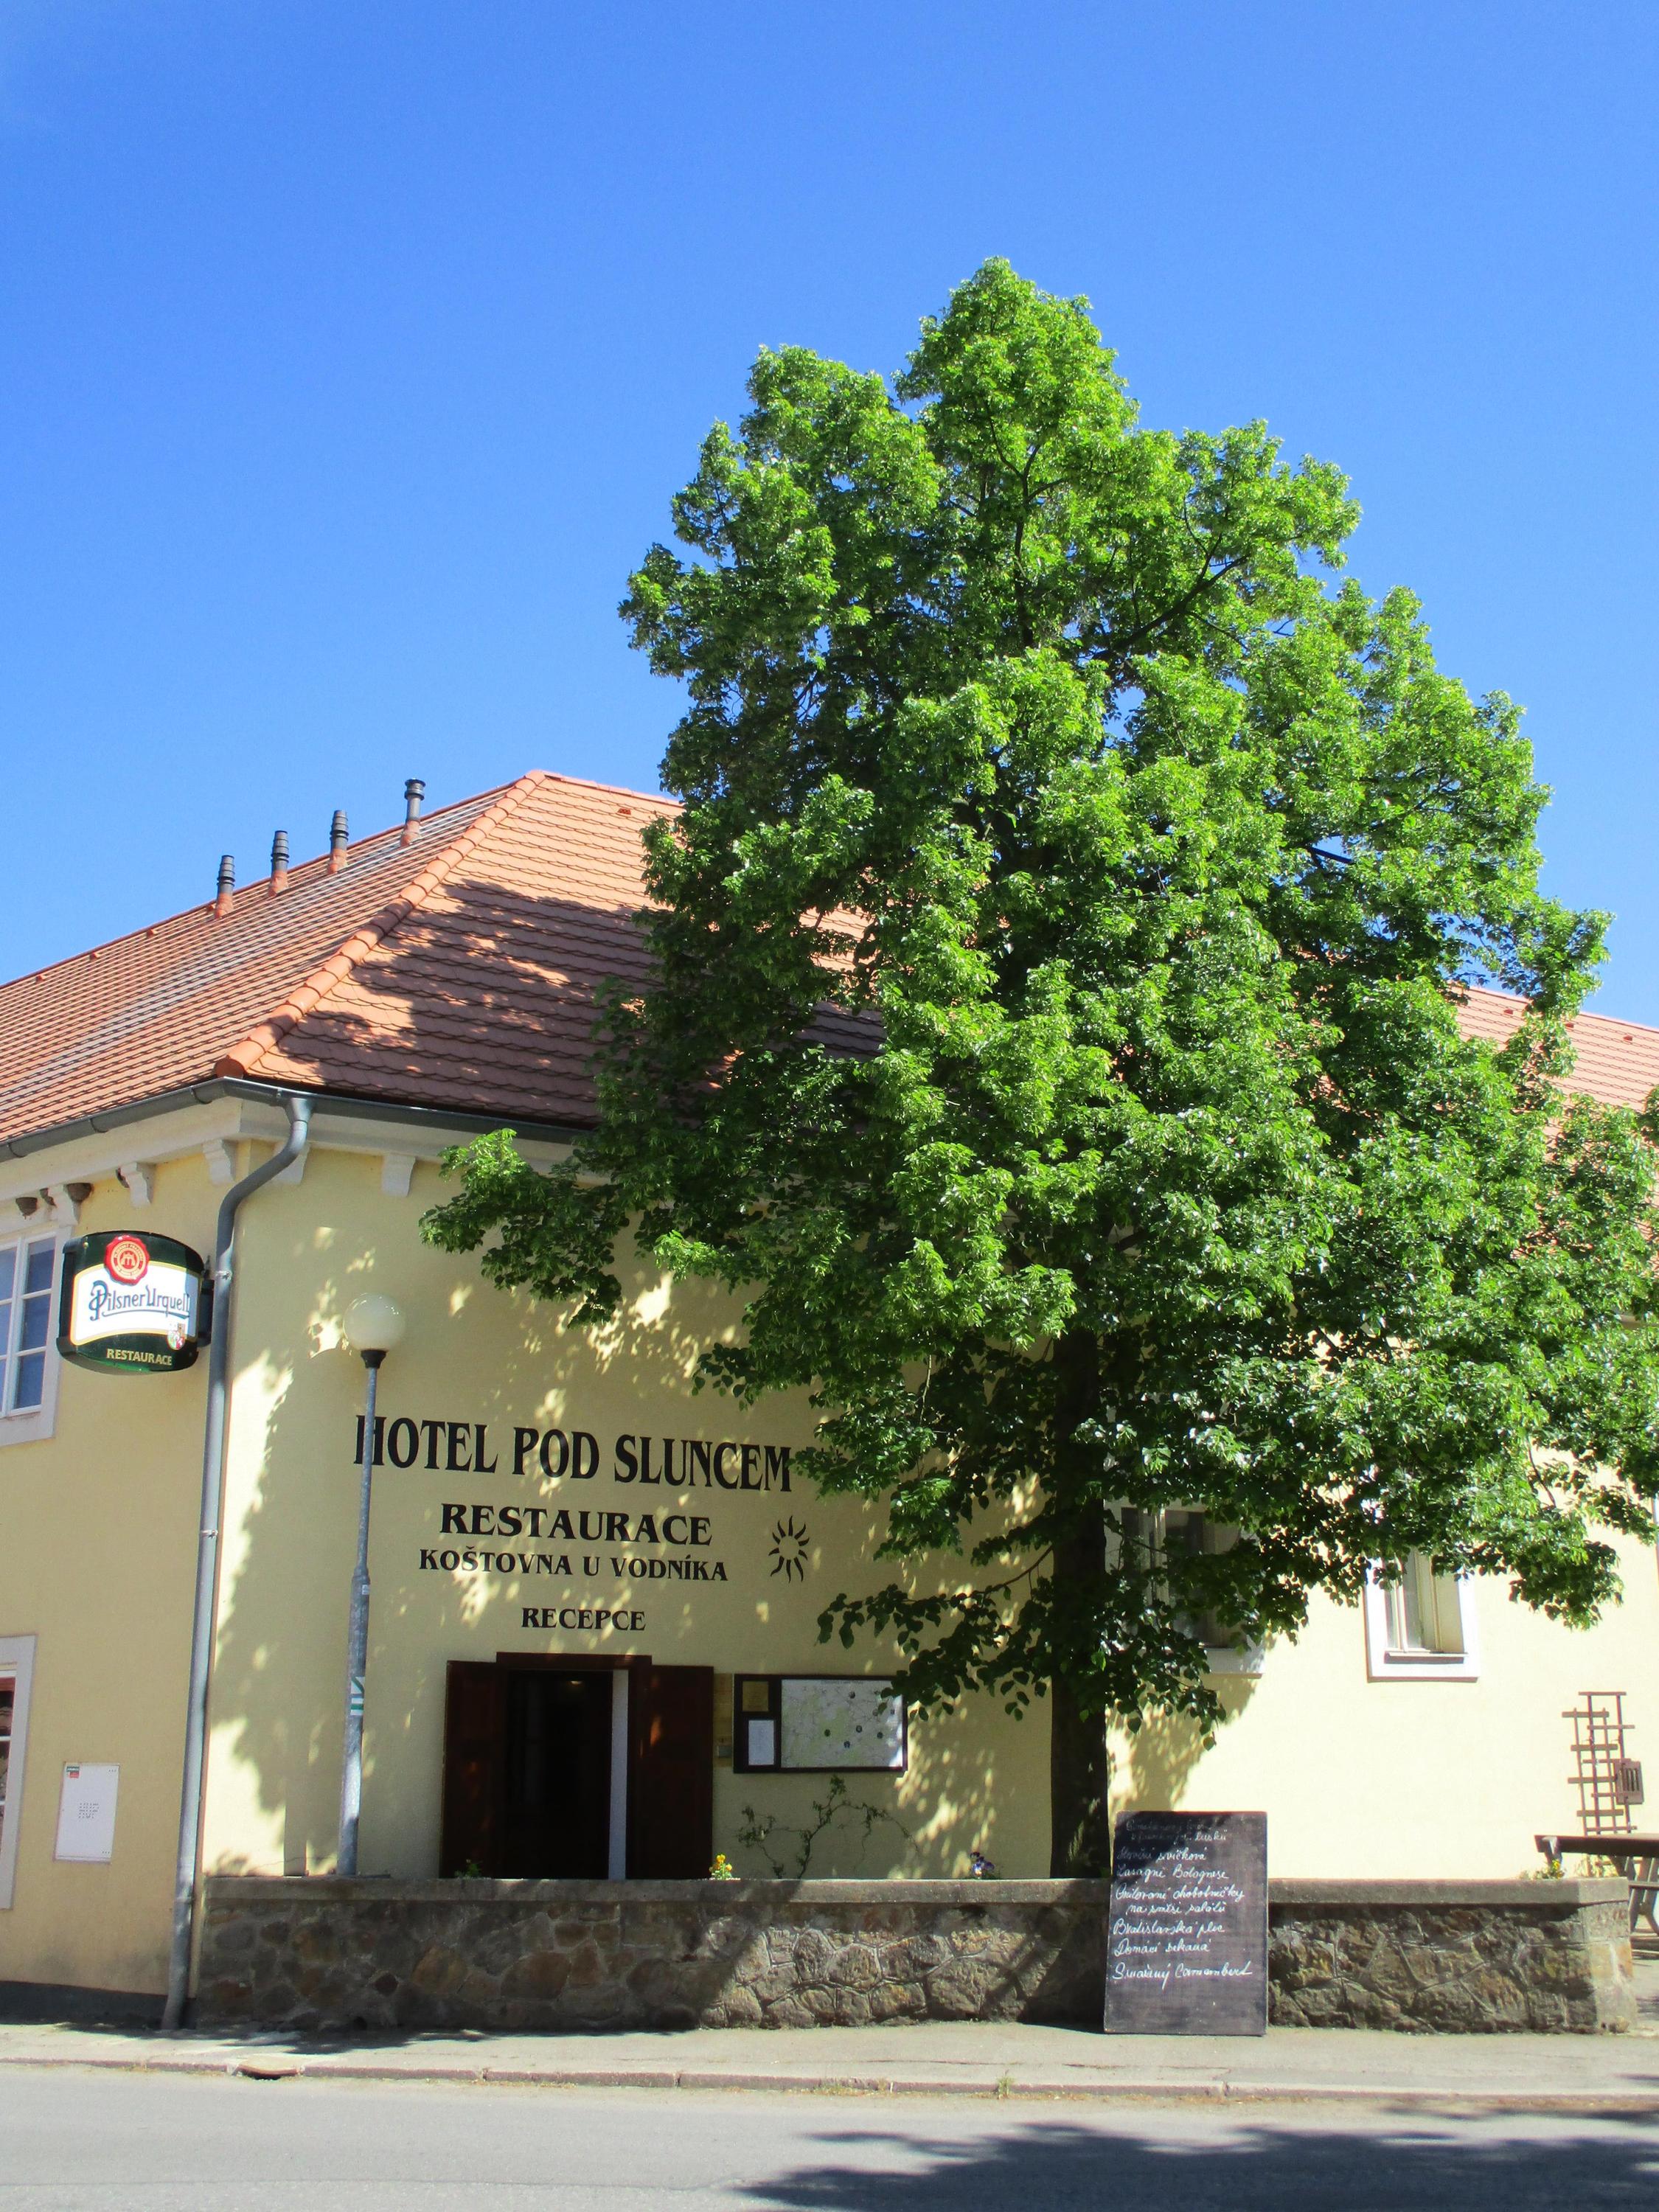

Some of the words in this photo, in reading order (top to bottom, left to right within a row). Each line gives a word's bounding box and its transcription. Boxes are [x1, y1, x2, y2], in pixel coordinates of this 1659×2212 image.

[88, 1279, 146, 1321] Pilsner
[146, 1284, 190, 1318] Urquell
[106, 1348, 173, 1366] RESTAURACE
[354, 1415, 498, 1473] HOTEL
[512, 1427, 599, 1479] POD
[614, 1434, 792, 1492] SLUNCEM
[440, 1503, 712, 1545] RESTAURACE
[420, 1545, 574, 1576] KOŠTOVNA
[582, 1557, 600, 1577] U
[611, 1554, 728, 1582] VODNÍKA
[521, 1607, 646, 1631] RECEPCE
